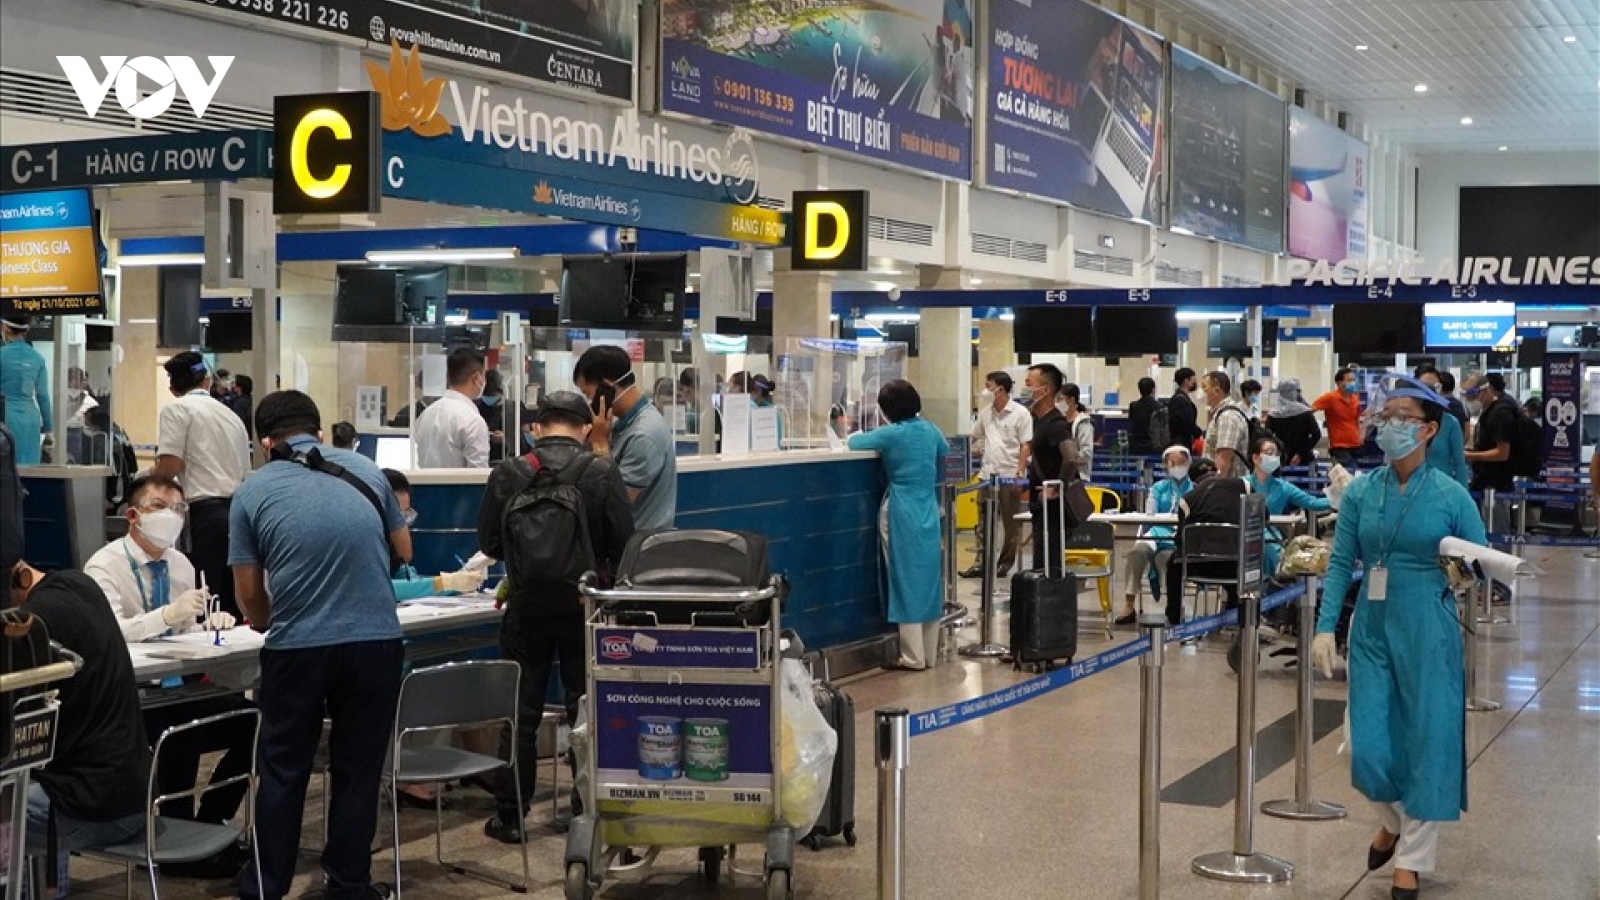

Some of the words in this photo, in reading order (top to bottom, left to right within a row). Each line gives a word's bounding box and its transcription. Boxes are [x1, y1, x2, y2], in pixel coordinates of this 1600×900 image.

[281, 0, 311, 21] 221
[317, 5, 349, 30] 226
[389, 26, 501, 64] novahillsmuine.com.vn
[547, 53, 603, 88] CENTARA
[723, 79, 751, 102] 0901
[754, 87, 772, 107] 136
[774, 93, 795, 112] 339
[449, 79, 604, 166] Vietnam
[606, 112, 723, 187] Airlines
[807, 95, 835, 144] BIỆT
[864, 107, 891, 152] BIỂN
[11, 148, 59, 184] C-1
[86, 148, 146, 176] HÀNG
[150, 149, 159, 172] /
[164, 147, 216, 171] ROW
[221, 136, 246, 172] C
[289, 107, 353, 200] C
[387, 155, 404, 188] C
[731, 214, 759, 236] HÀNG
[764, 222, 787, 239] ROW
[804, 202, 850, 260] D
[51, 240, 72, 255] GIA
[31, 258, 59, 275] Class
[1279, 256, 1425, 287] PACIFIC
[1045, 290, 1068, 302] E-6
[1128, 289, 1151, 302] E-5
[1367, 286, 1394, 299] E-4
[1451, 286, 1478, 299] E-3
[604, 642, 628, 653] TOA
[627, 693, 654, 704] CÔNG
[683, 697, 704, 706] CHO
[706, 696, 732, 708] CUỘC
[648, 723, 673, 734] TOA
[694, 725, 720, 736] TOA
[917, 712, 938, 731] TIA
[609, 788, 661, 799] BIZMAN.VN
